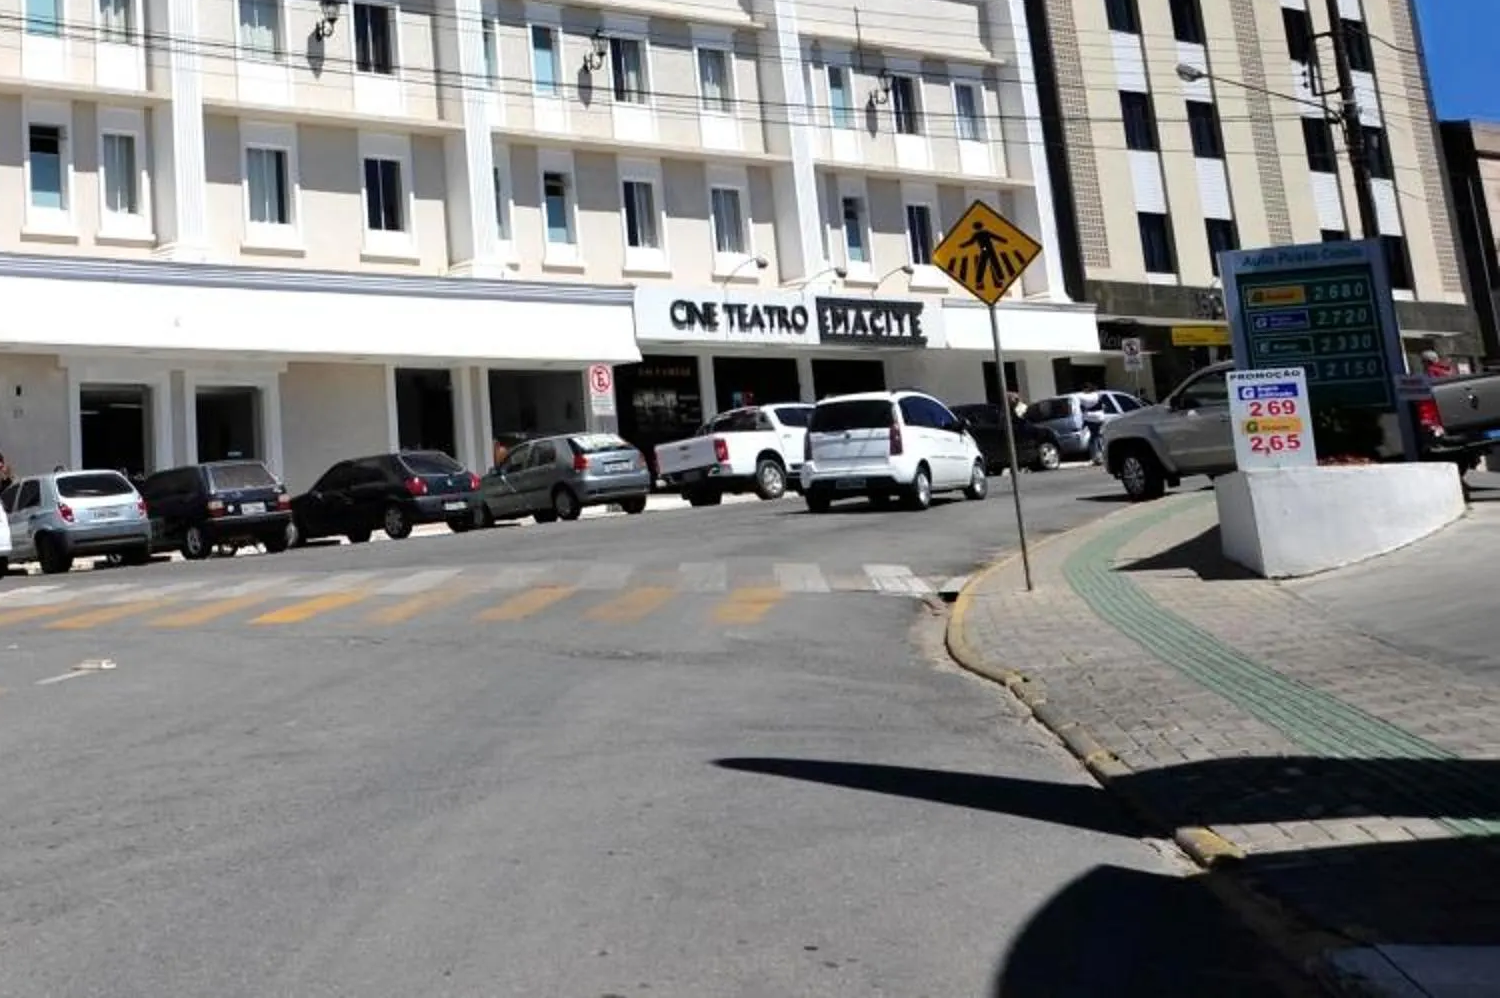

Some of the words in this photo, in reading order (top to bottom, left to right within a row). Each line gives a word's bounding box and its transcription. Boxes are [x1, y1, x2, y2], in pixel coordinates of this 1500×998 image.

[669, 300, 719, 332] CINE
[722, 304, 809, 335] TEATRO
[816, 300, 926, 343] EMACITE
[1250, 433, 1301, 456] 2,65
